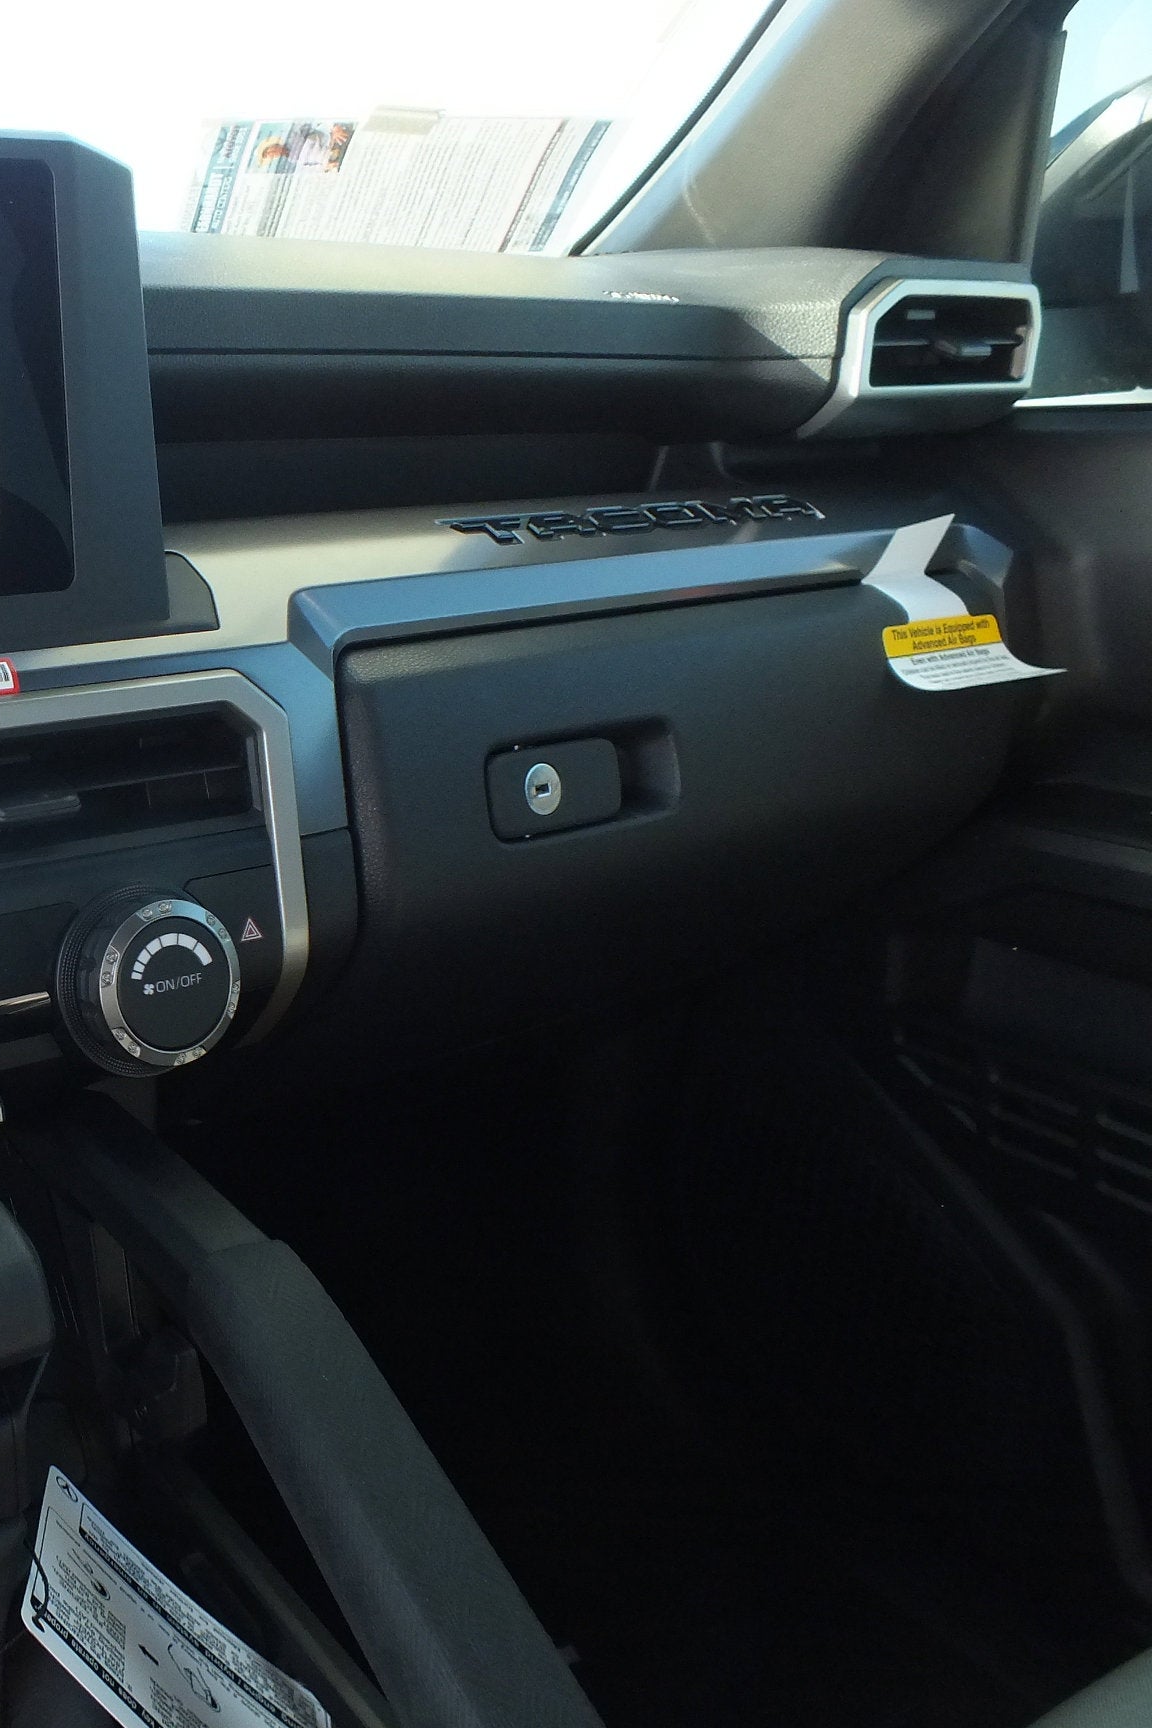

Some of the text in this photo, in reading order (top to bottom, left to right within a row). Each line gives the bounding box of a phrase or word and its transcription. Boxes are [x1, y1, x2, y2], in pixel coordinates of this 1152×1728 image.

[434, 493, 825, 546] TACOMA
[892, 619, 990, 641] This Vehicle is Equipped with
[913, 634, 976, 651] Advanced Air Bags
[155, 973, 203, 994] ON/OFF
